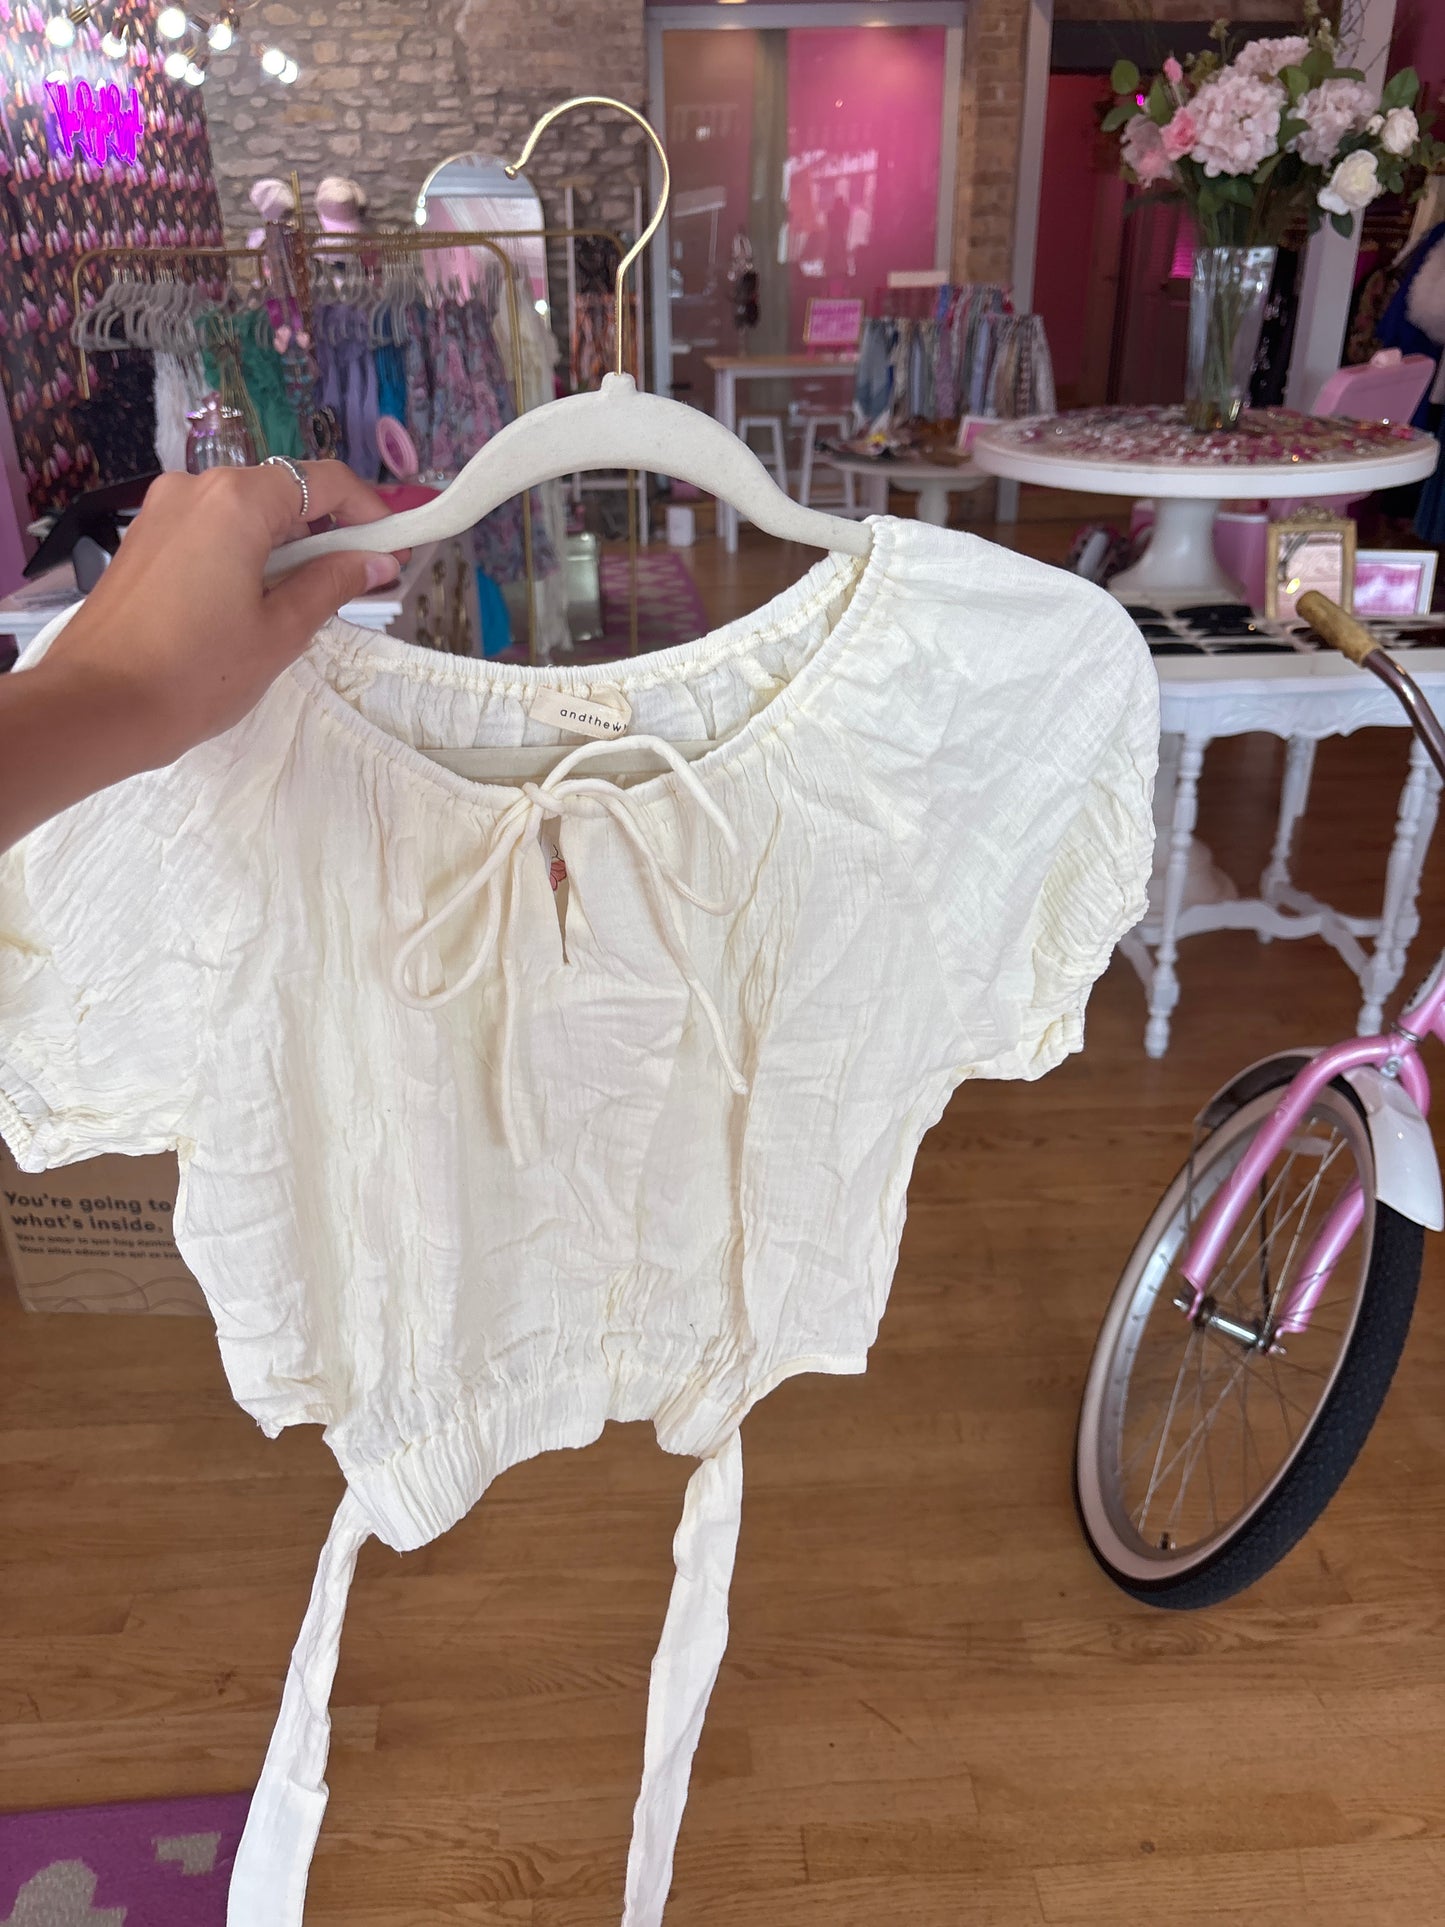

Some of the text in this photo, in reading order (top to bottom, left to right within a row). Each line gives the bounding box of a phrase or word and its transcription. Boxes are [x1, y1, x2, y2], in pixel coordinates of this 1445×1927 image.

[4, 1190, 172, 1214] You're going to
[11, 1213, 163, 1233] what's inside.
